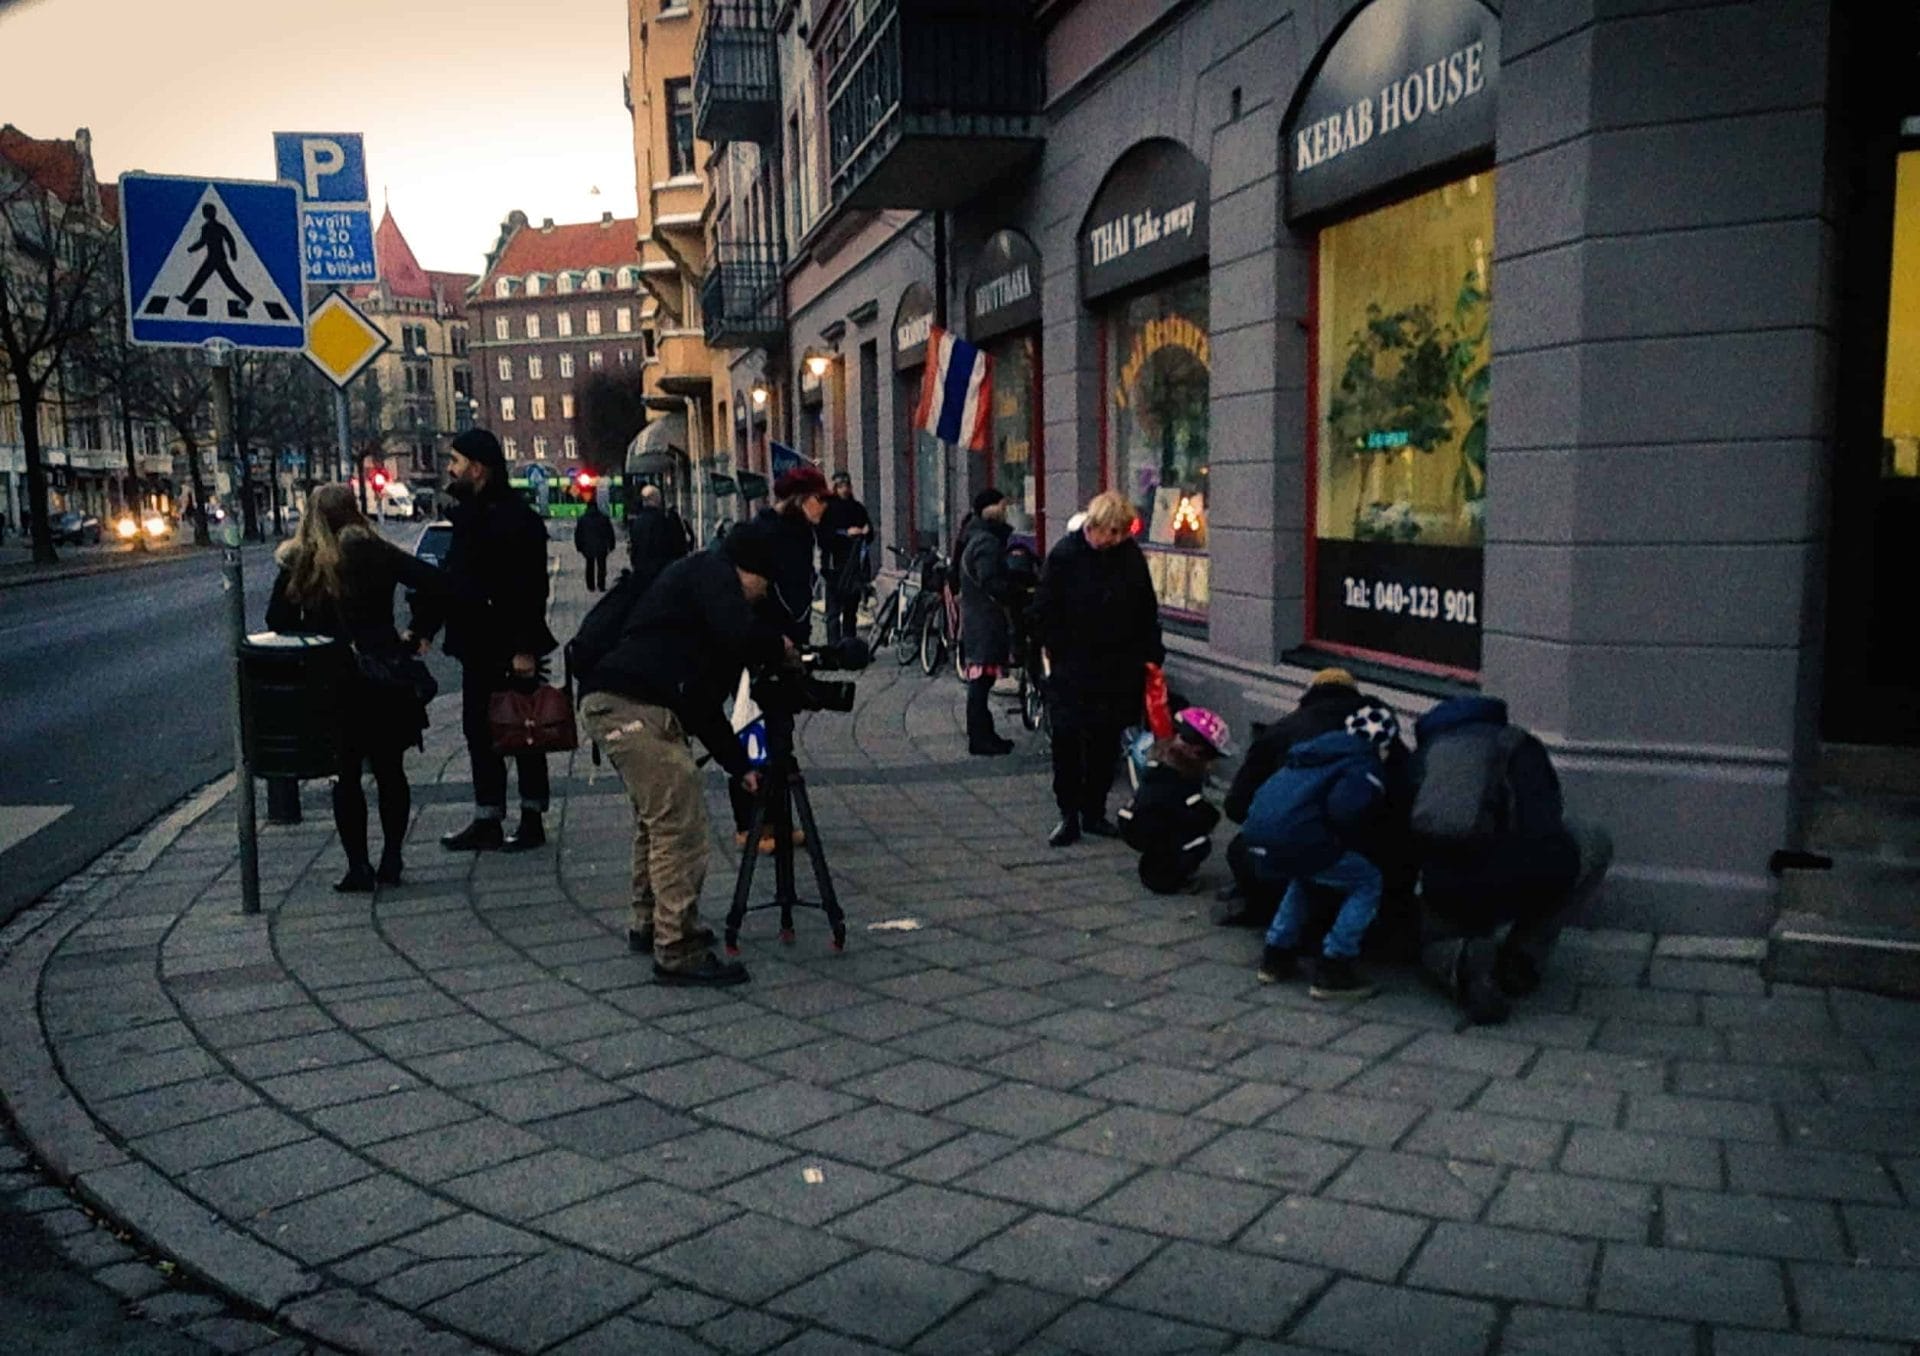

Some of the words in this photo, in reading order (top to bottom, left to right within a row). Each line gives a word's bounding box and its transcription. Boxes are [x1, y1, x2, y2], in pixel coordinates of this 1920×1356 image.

[1297, 98, 1373, 171] KEBAB
[1379, 42, 1484, 134] HOUSE
[302, 138, 345, 198] P
[1091, 213, 1129, 266] THAI
[1132, 207, 1160, 250] Take
[1163, 201, 1197, 238] away
[1443, 590, 1477, 625] 901
